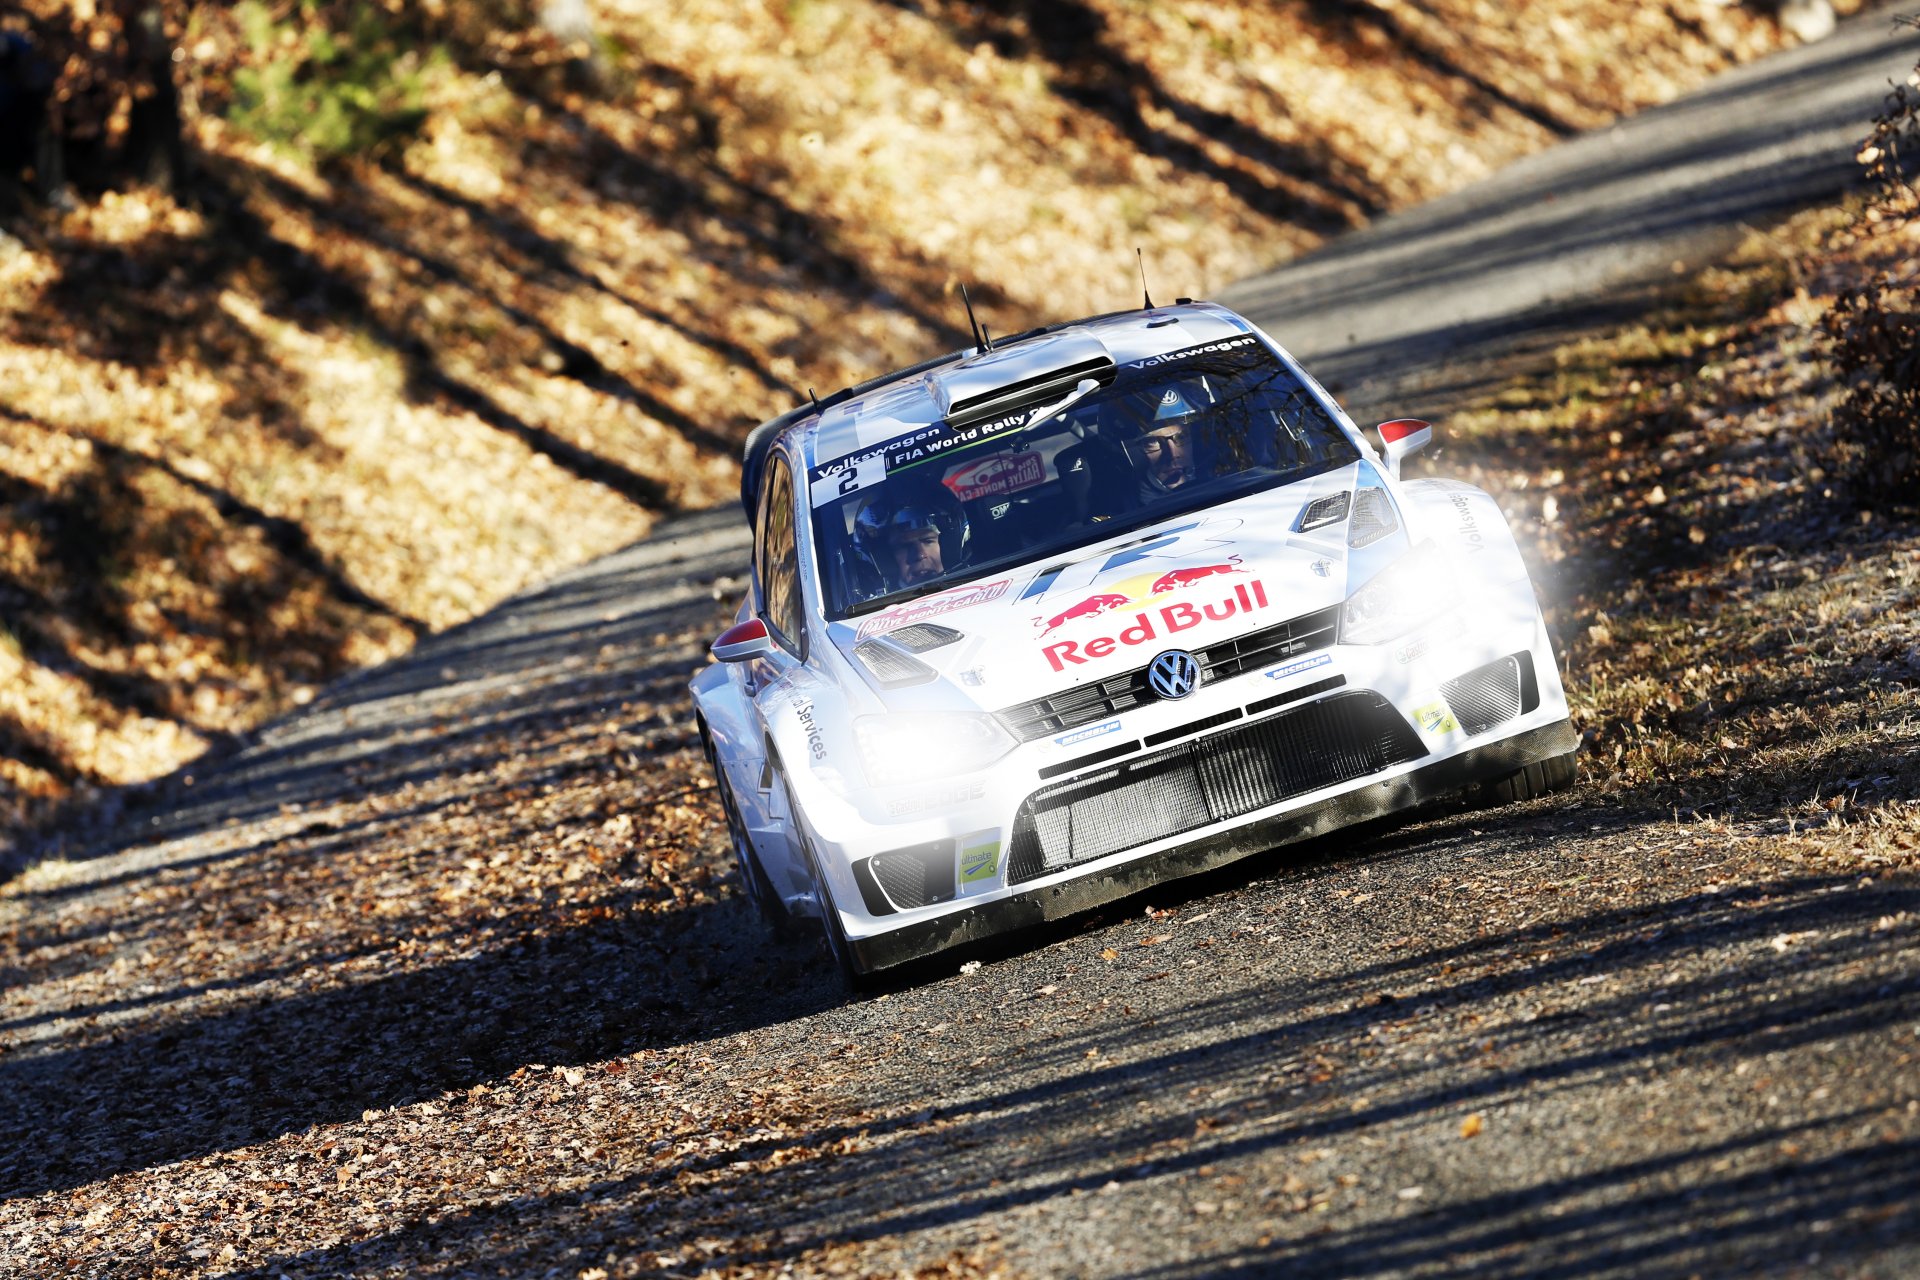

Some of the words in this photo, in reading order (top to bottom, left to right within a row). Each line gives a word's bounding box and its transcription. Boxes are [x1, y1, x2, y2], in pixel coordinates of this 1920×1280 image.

[1128, 337, 1256, 370] Volkswagen
[817, 427, 940, 478] Volkswagen
[895, 448, 924, 465] FIA
[926, 428, 978, 453] World
[981, 414, 1025, 435] Rally
[837, 467, 859, 496] 2
[1042, 612, 1156, 673] Red
[1159, 579, 1268, 634] Bull
[797, 704, 827, 761] Services
[961, 851, 992, 866] ultimate
